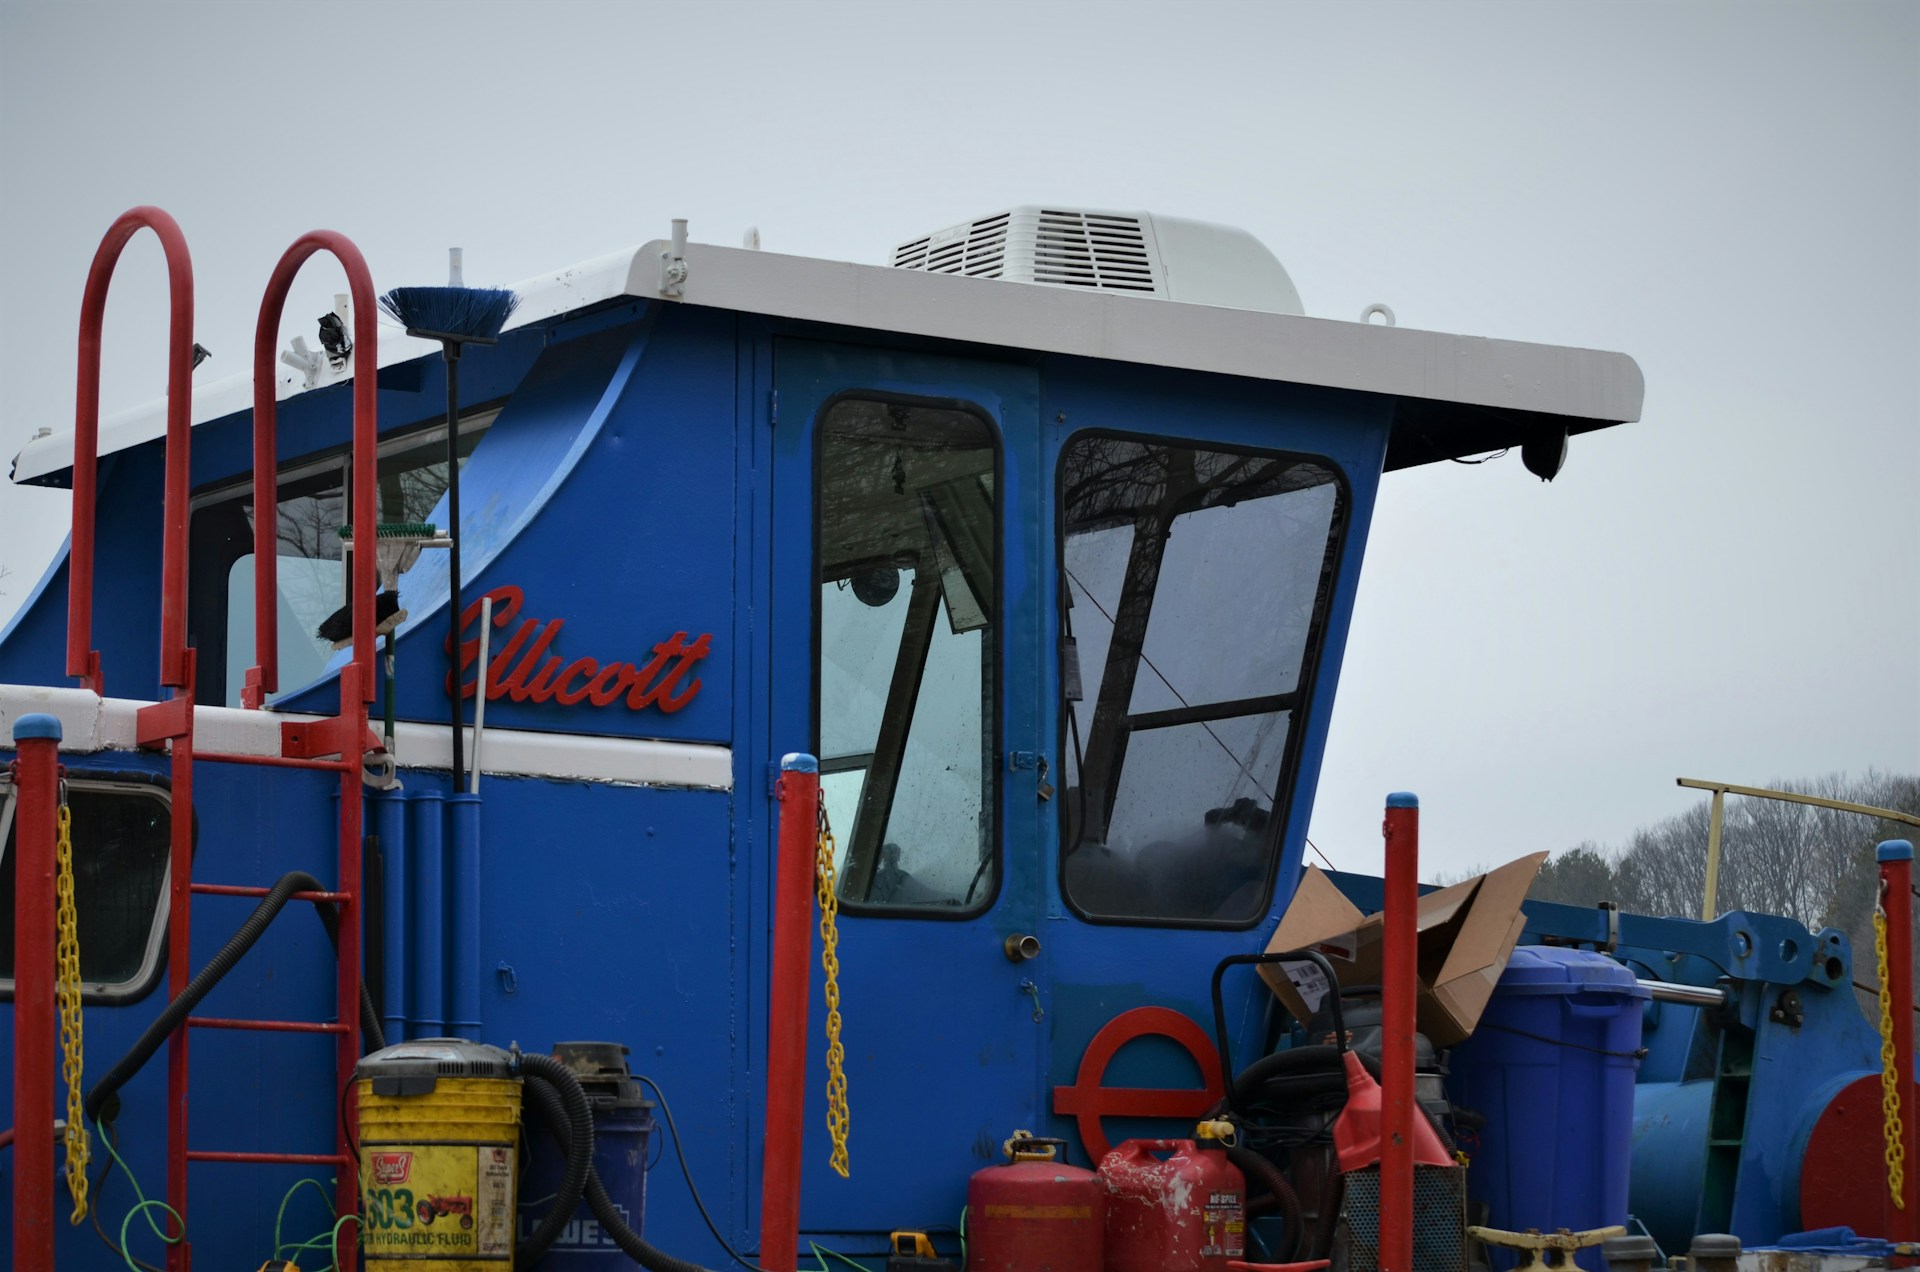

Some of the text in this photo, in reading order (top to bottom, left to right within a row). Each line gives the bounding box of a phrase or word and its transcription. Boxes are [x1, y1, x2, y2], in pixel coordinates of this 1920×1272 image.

[445, 584, 713, 713] Ellicott
[365, 1188, 415, 1230] 303
[376, 1232, 435, 1246] HYDRAULIC
[438, 1232, 472, 1246] FLUID
